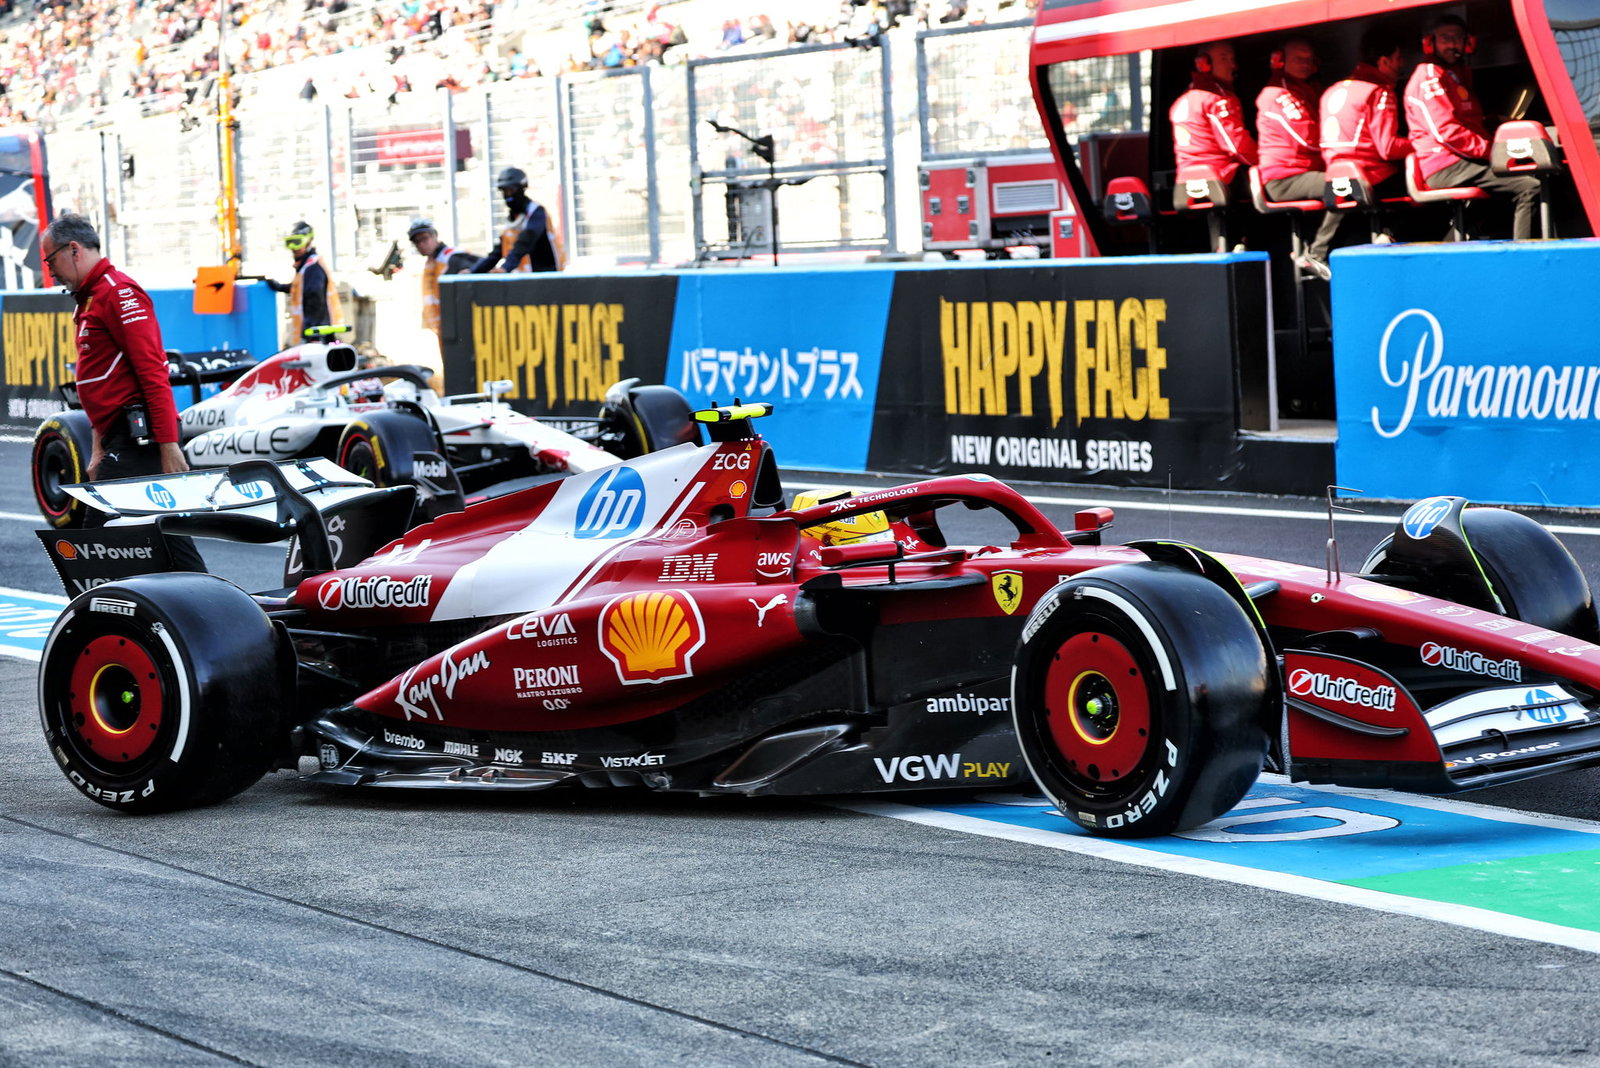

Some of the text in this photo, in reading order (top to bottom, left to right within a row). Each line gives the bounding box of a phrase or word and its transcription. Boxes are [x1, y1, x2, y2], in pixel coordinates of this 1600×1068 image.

[3, 311, 56, 392] HAPPY
[472, 302, 625, 409] HAPPY FACE
[940, 295, 1170, 428] HAPPY FACE
[681, 347, 864, 400] パラマウントプラス
[192, 426, 299, 457] ORACLE
[951, 435, 1153, 473] NEW ORIGINAL SERIES
[413, 461, 447, 478] Mobil
[579, 467, 642, 540] hp
[858, 487, 919, 503] TECHNOLOGY
[1406, 498, 1445, 537] hp
[77, 542, 153, 561] V-Power
[757, 552, 791, 567] aws
[658, 553, 718, 582] IBM
[343, 576, 431, 607] UniCredit
[90, 598, 137, 617] PIRELLI
[1022, 593, 1060, 644] PIRELLI
[537, 637, 578, 648] LOGISTICS
[513, 665, 580, 689] PERONI
[1442, 646, 1521, 682] UniCredit
[516, 687, 583, 699] NASTRO AZZURRO
[542, 698, 571, 711] 0.0%
[926, 694, 1011, 716] ambipar
[1312, 674, 1396, 712] UniCredit
[383, 729, 425, 750] brembo
[443, 740, 479, 757] MAHLE
[1455, 741, 1560, 764] V-Power
[493, 748, 523, 763] NGK
[541, 752, 578, 765] SKF
[873, 753, 1011, 784] VGW PLAY
[69, 770, 135, 803] ZERO
[1106, 769, 1170, 829] ZERO
